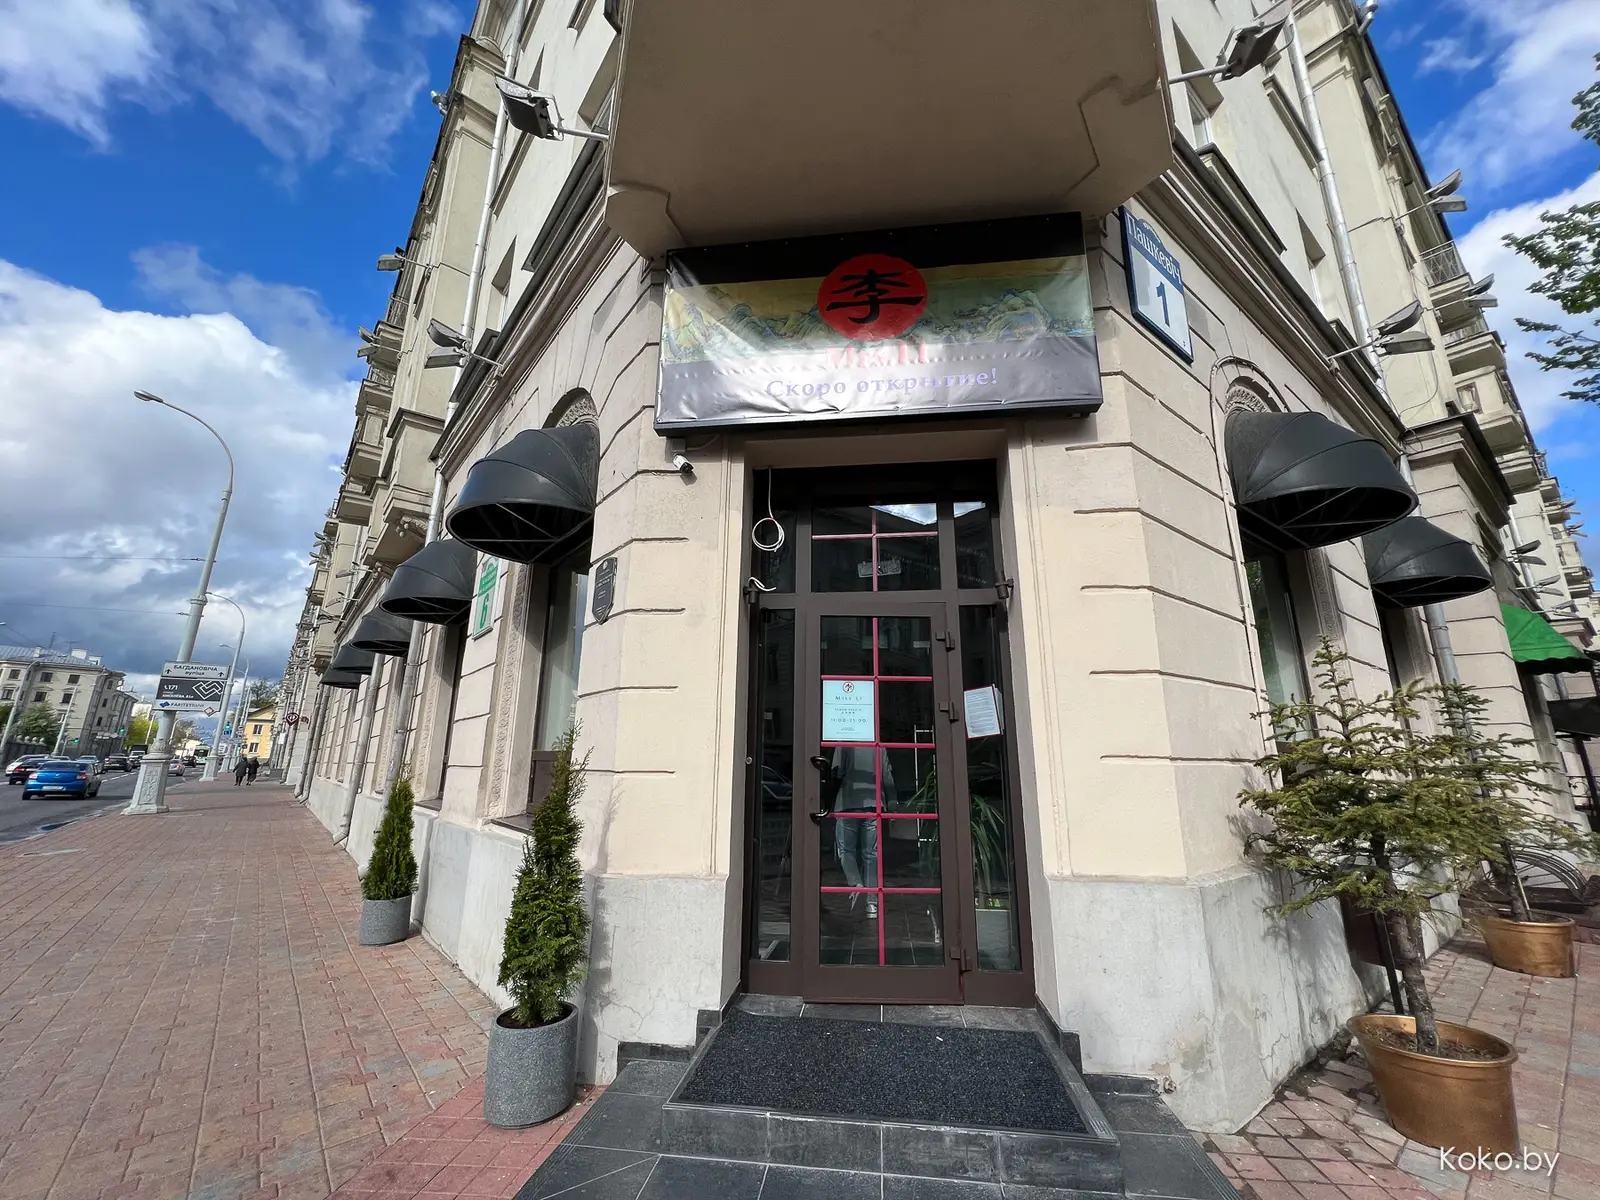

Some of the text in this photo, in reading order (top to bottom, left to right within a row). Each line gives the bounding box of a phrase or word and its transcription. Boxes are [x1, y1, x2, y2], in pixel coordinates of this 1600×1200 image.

[1125, 212, 1182, 284] Пашкевіч
[825, 268, 924, 325] 李
[1156, 281, 1171, 327] 1
[765, 367, 998, 400] Скоро открытие!
[480, 593, 490, 629] 6
